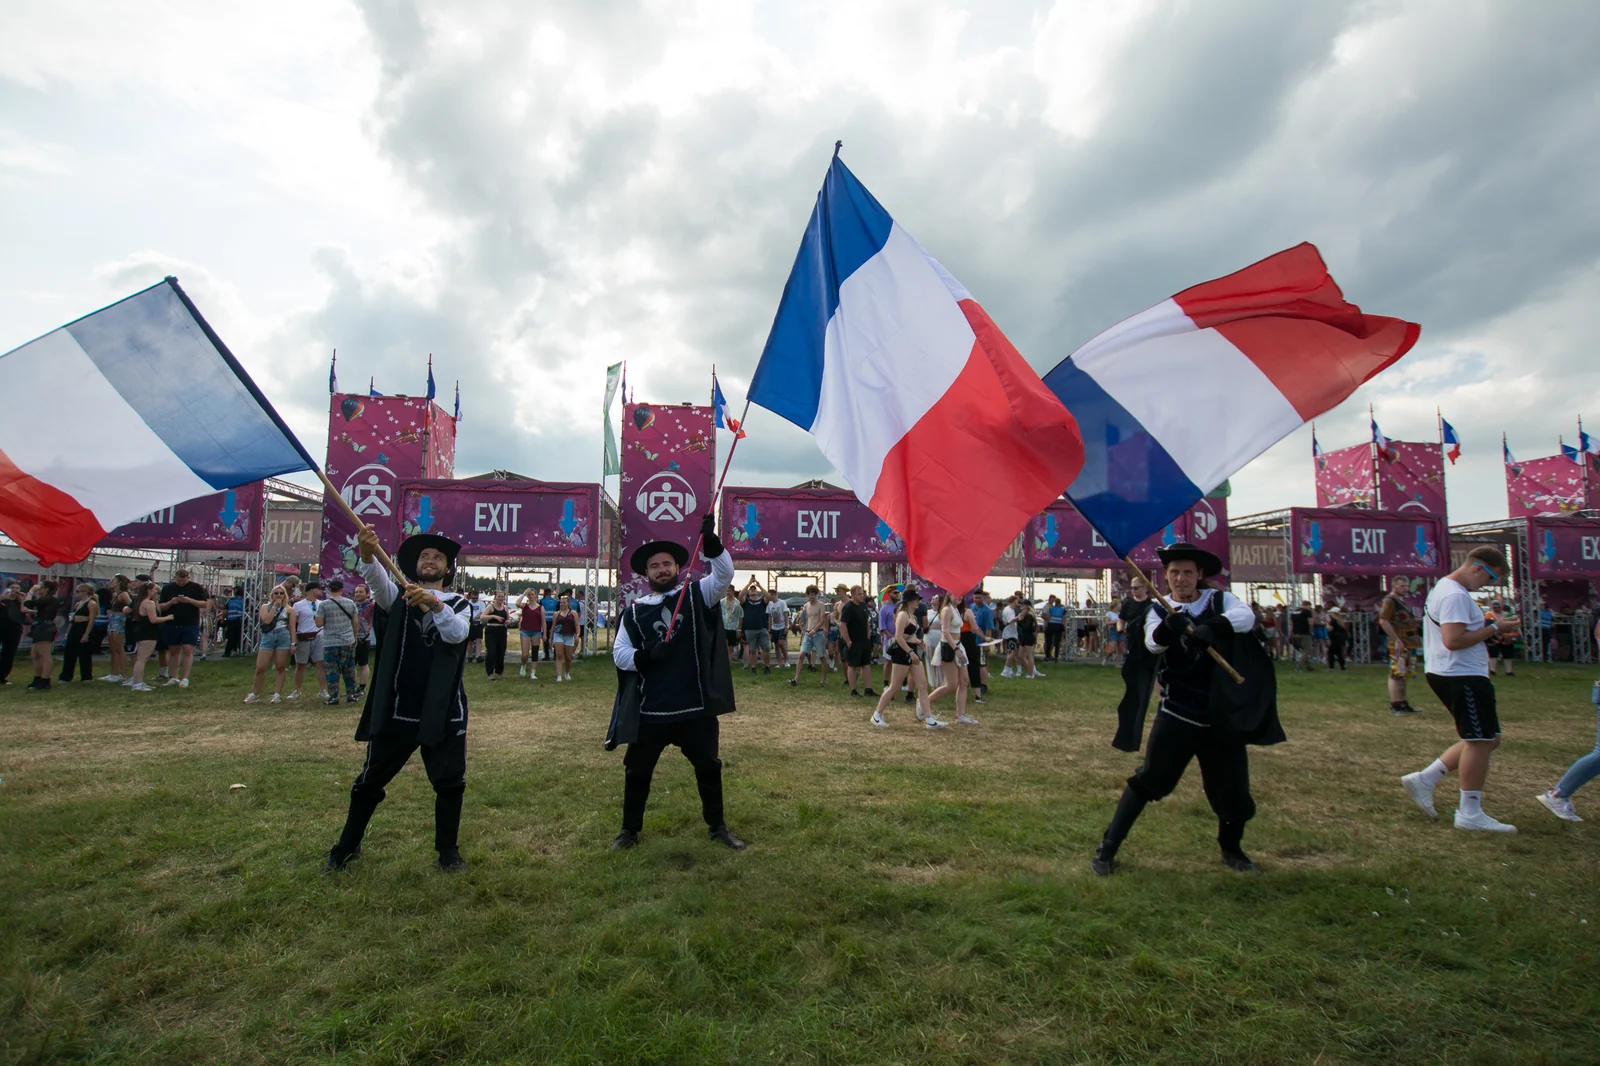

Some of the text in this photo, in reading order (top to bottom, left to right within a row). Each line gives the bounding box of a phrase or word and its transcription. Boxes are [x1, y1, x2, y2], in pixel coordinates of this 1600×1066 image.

[475, 503, 522, 532] EXIT
[797, 510, 841, 538] EXIT
[1351, 528, 1386, 554] EXIT
